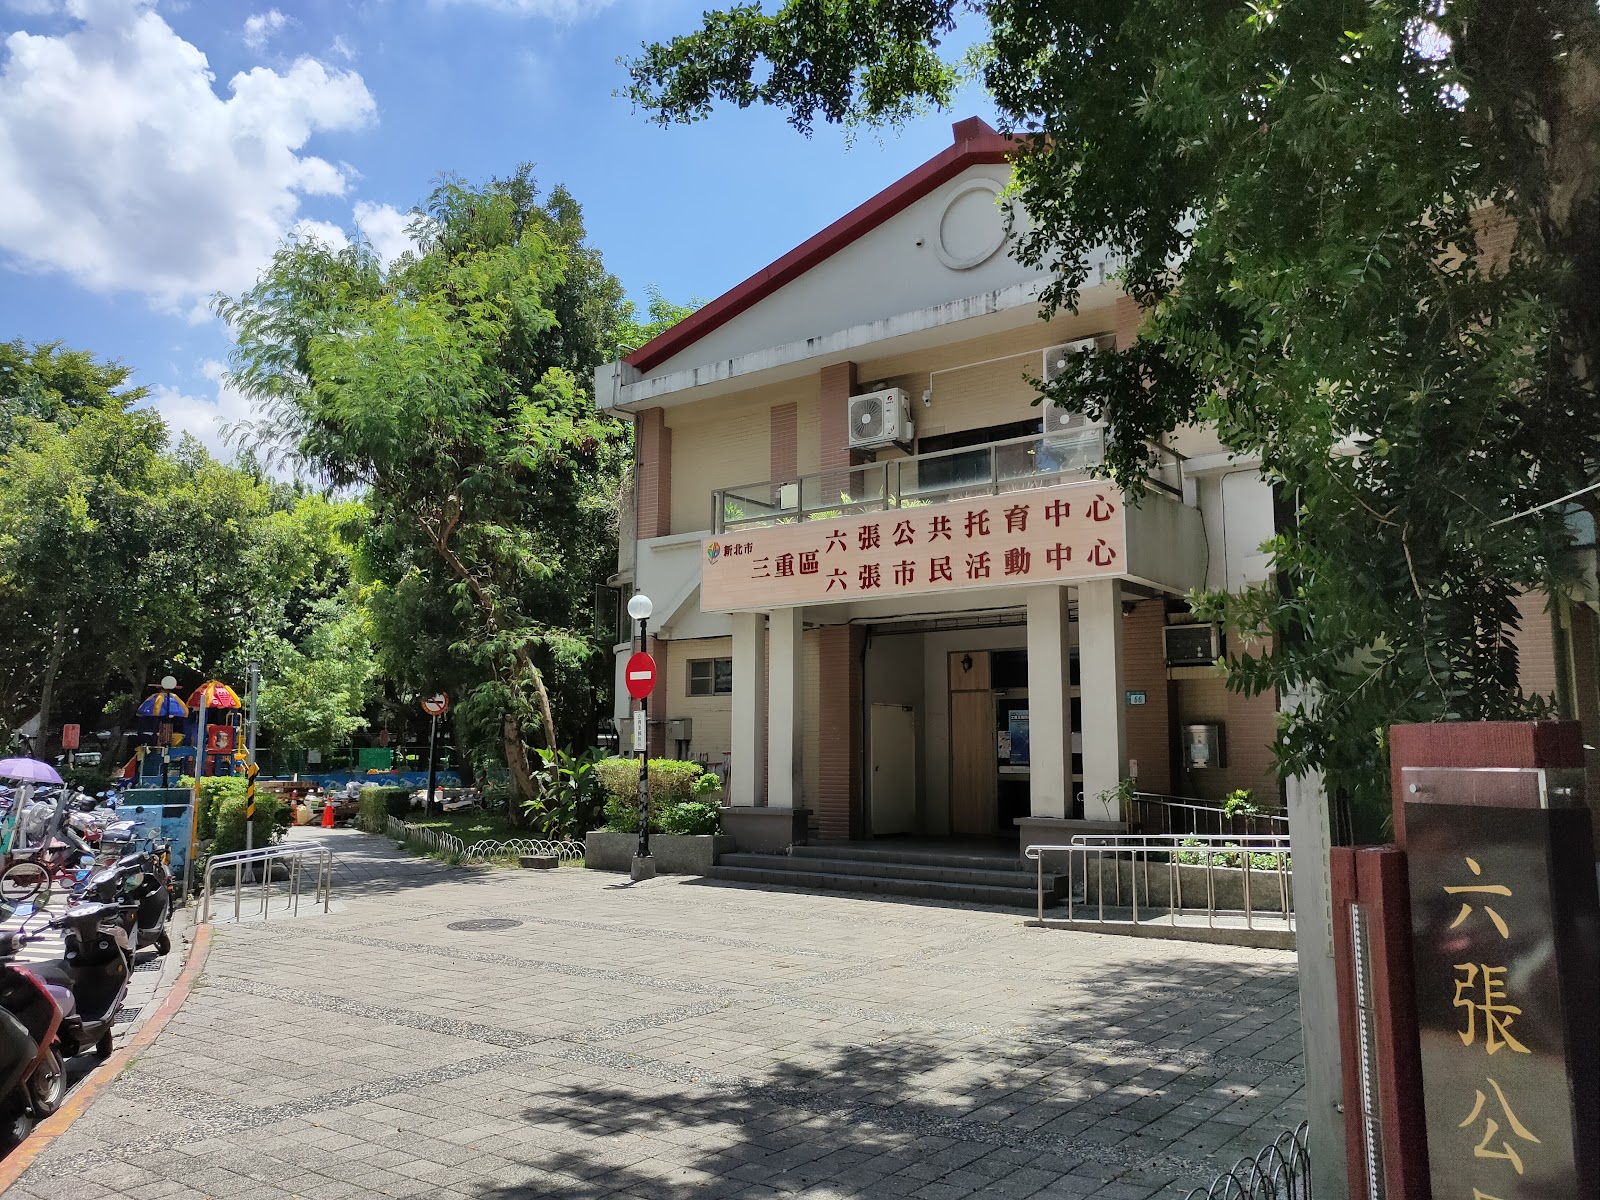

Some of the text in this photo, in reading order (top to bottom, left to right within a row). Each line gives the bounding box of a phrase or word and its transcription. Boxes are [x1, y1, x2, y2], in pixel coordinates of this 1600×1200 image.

[723, 542, 753, 557] 新北市
[825, 494, 1115, 554] 六張公共托育中心
[751, 549, 820, 579] 三重區
[825, 538, 1117, 592] 六張市民活動中心
[1443, 857, 1541, 1200] 六張公
